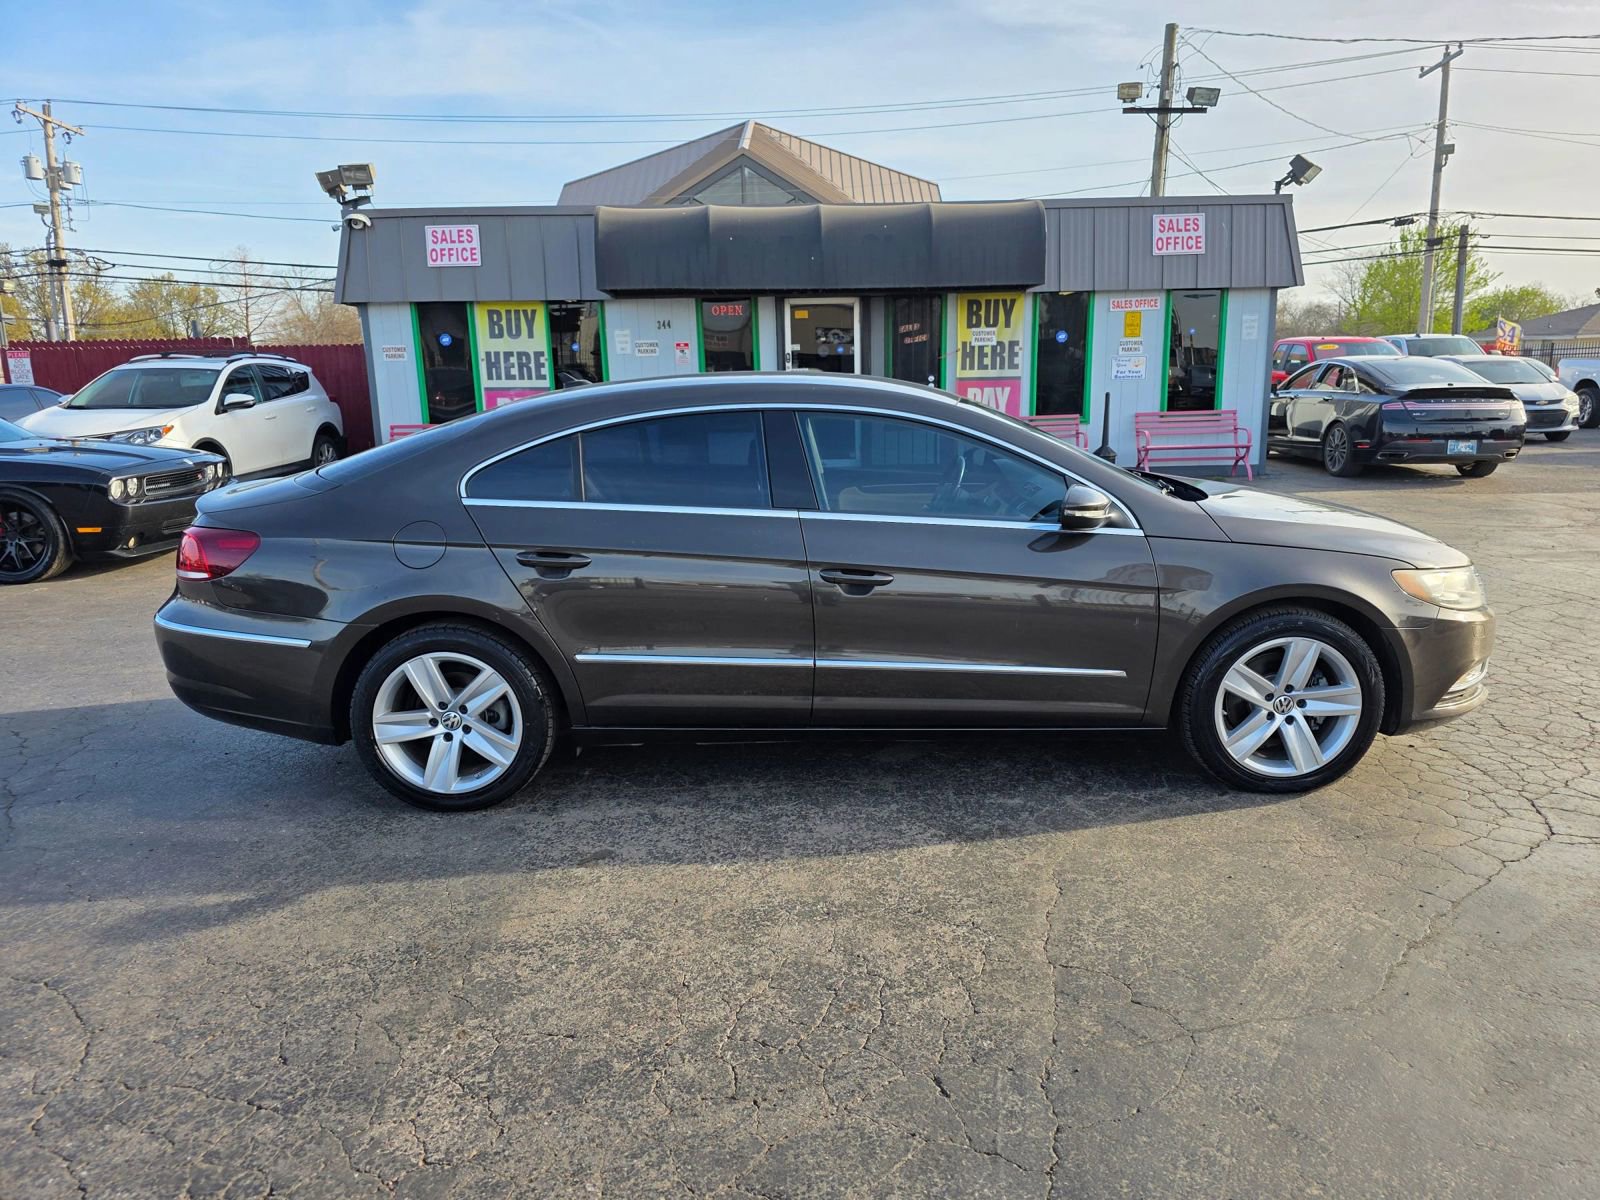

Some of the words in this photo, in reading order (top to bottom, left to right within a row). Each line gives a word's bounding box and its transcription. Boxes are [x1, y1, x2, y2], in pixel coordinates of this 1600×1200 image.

[1158, 217, 1200, 233] SALES
[431, 228, 474, 245] SALES
[1156, 235, 1202, 251] OFFICE
[430, 247, 478, 262] OFFICE
[711, 304, 743, 316] OPEN
[1111, 299, 1133, 309] SALES
[1134, 298, 1159, 308] OFFICE
[966, 299, 1017, 329] BUY
[486, 309, 537, 339] BUY
[656, 320, 671, 330] 344
[961, 340, 1020, 371] HERE
[485, 351, 547, 381] HERE
